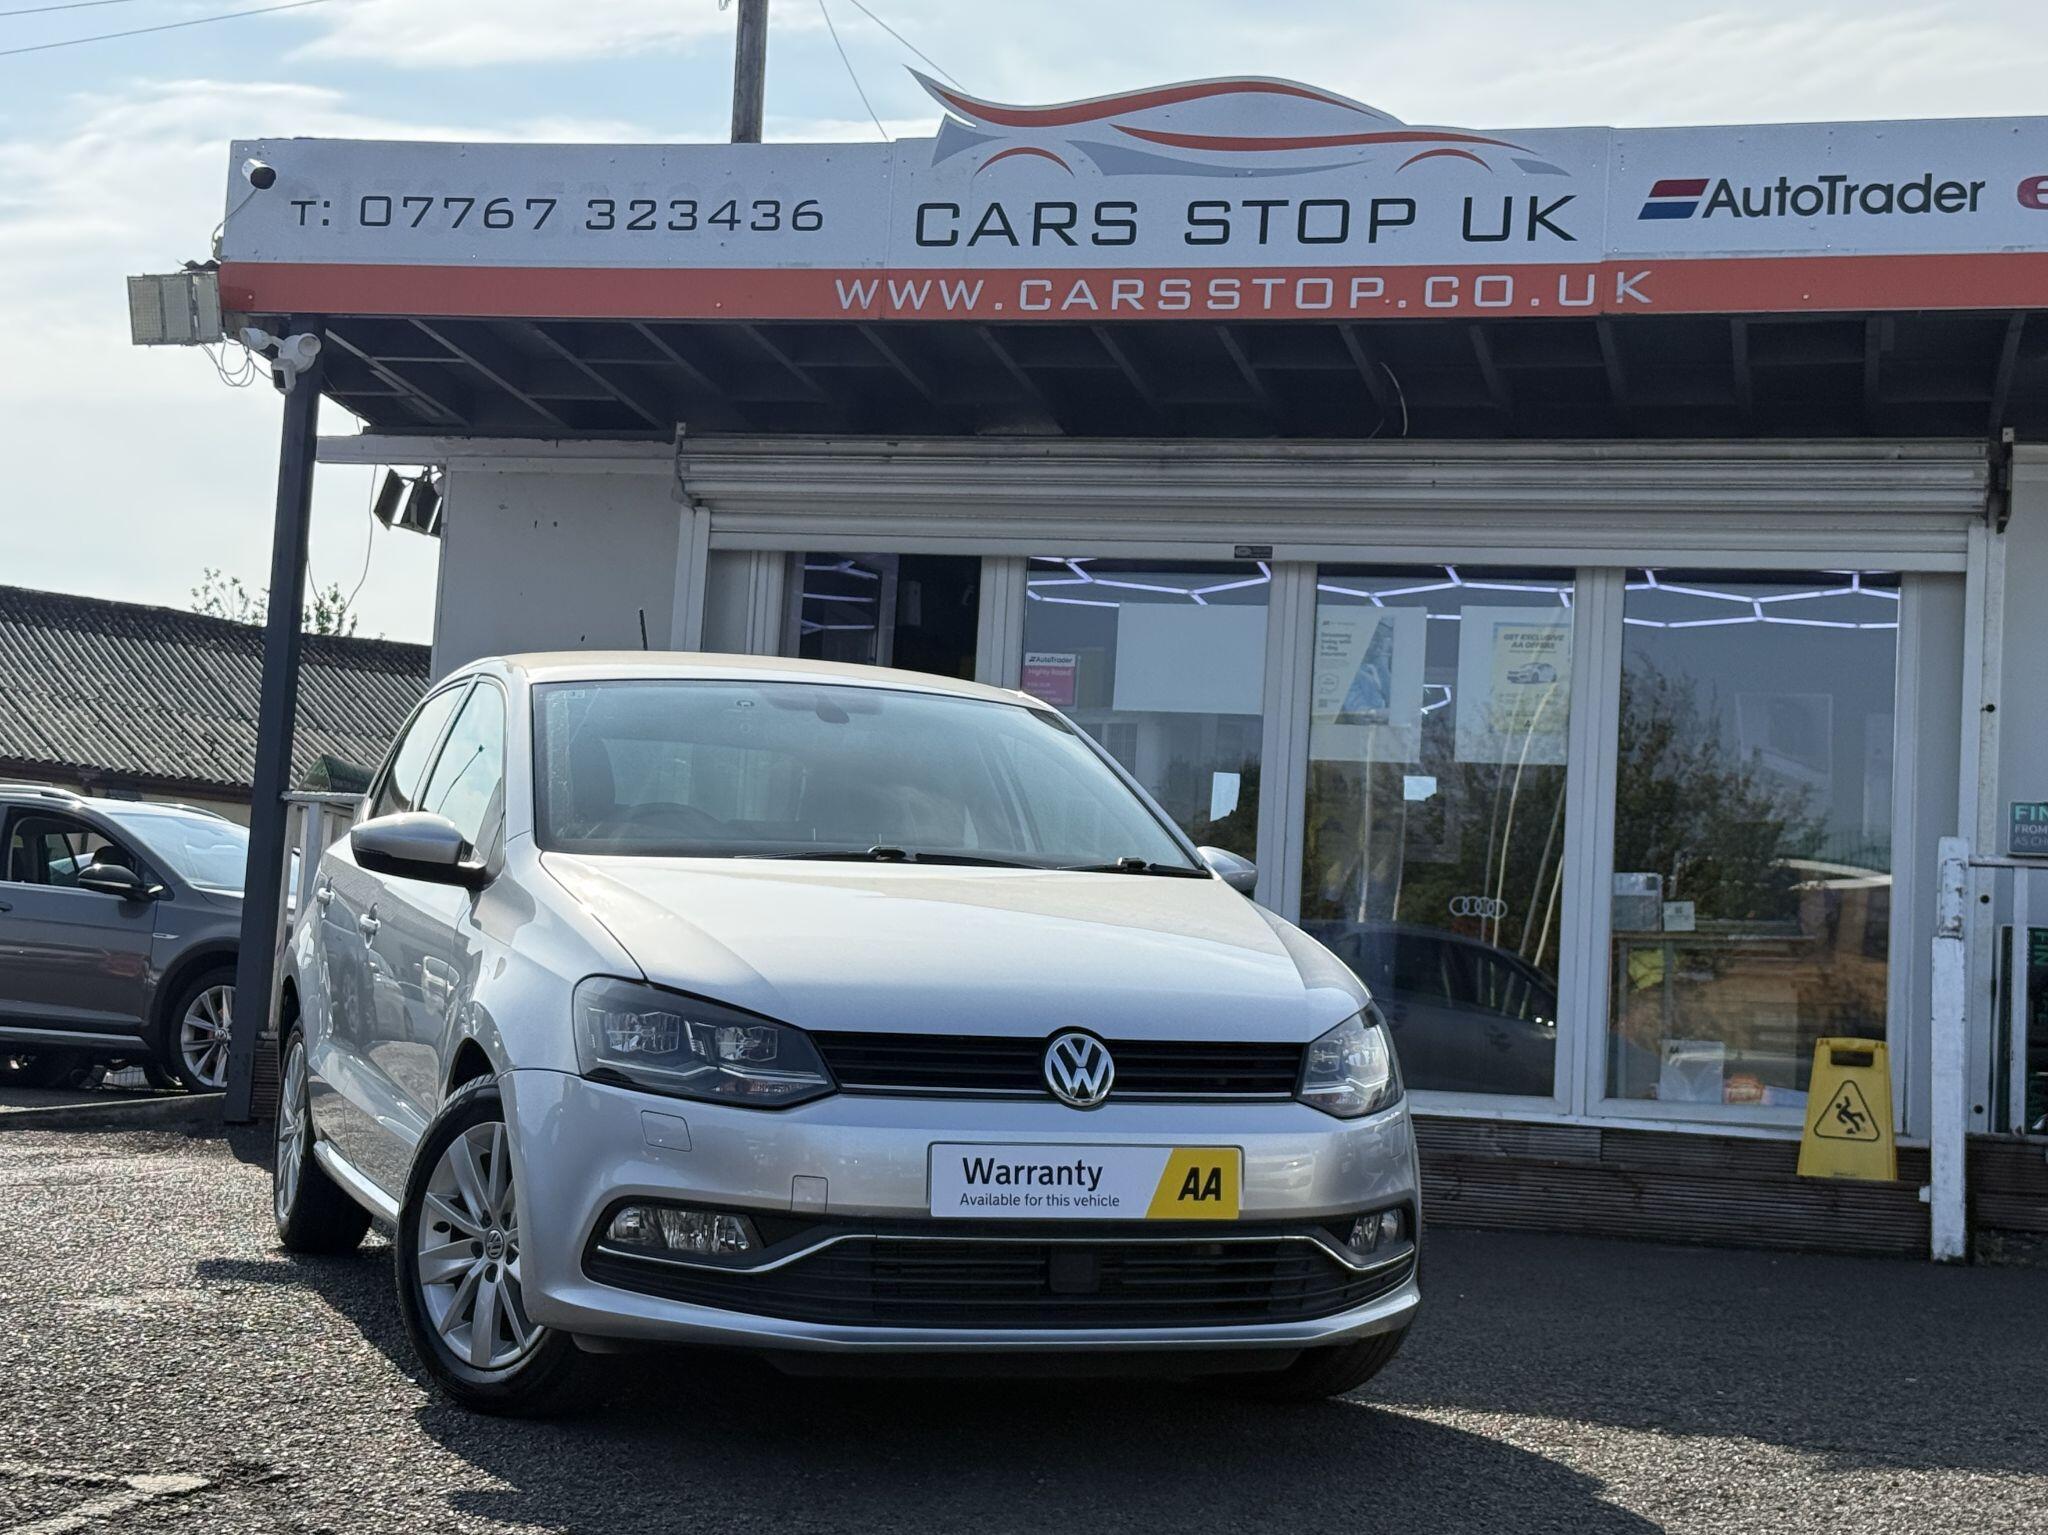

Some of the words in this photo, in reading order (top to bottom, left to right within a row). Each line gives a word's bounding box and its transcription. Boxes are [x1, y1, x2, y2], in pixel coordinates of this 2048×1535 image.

[1702, 173, 1986, 218] AutoTrader
[290, 200, 331, 227] T:
[359, 196, 557, 230] 07767
[585, 199, 825, 232] 323436
[915, 202, 1138, 247] CARS
[1184, 199, 1416, 245] STOP
[1462, 194, 1578, 242] UK
[836, 271, 1653, 311] WWW.CARSSTOP.CO.UK
[962, 1157, 1103, 1192] Warranty
[1177, 1166, 1222, 1201] AA
[960, 1193, 1021, 1207] Available
[1024, 1192, 1043, 1207] for
[1046, 1193, 1070, 1207] this
[1073, 1193, 1120, 1208] vehicle
